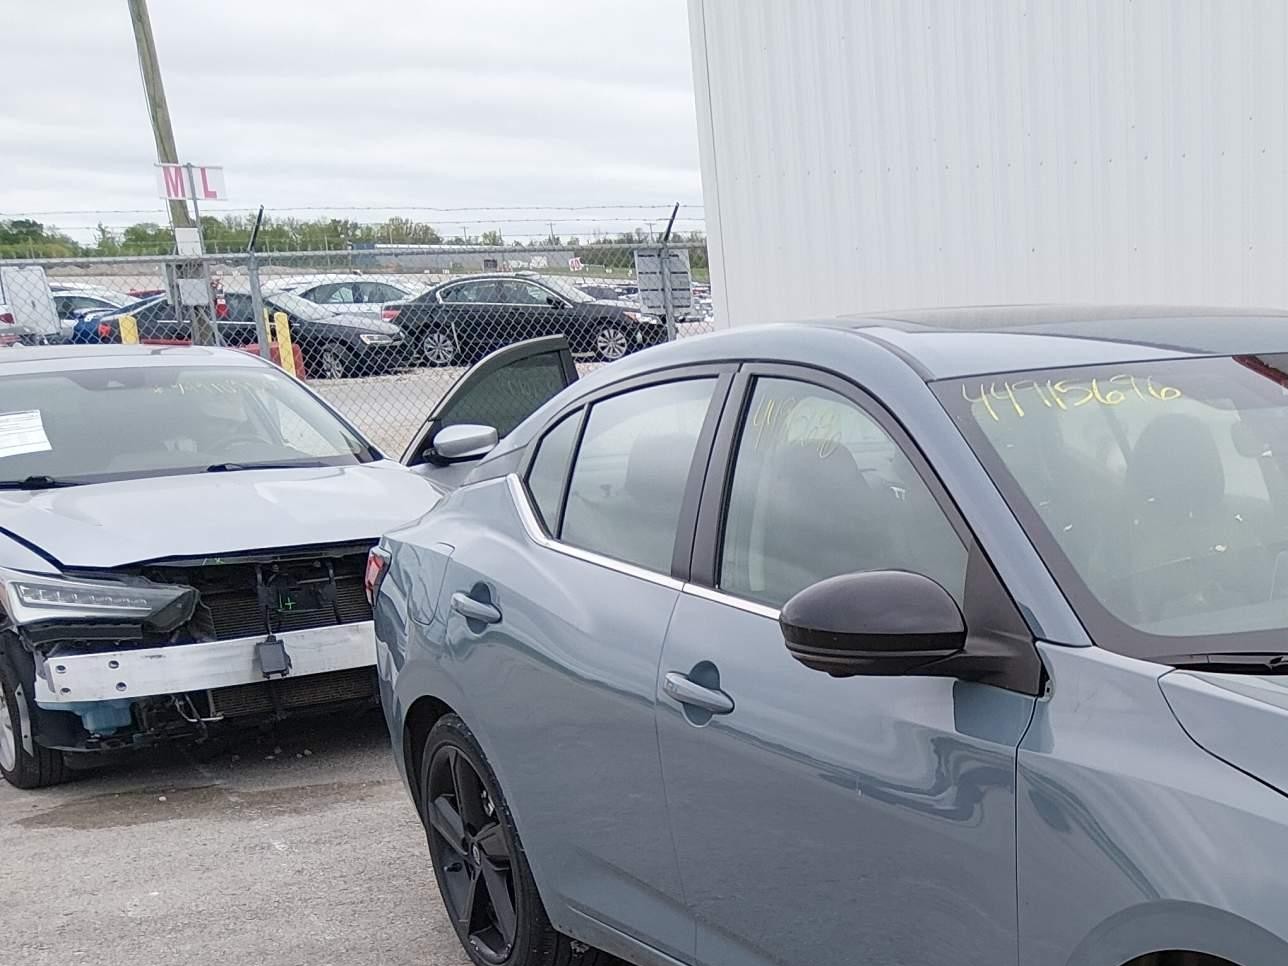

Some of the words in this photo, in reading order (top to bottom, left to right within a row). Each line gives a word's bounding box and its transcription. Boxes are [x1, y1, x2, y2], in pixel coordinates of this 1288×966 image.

[162, 166, 186, 198] M
[200, 167, 218, 198] L
[961, 374, 1182, 421] 44915696
